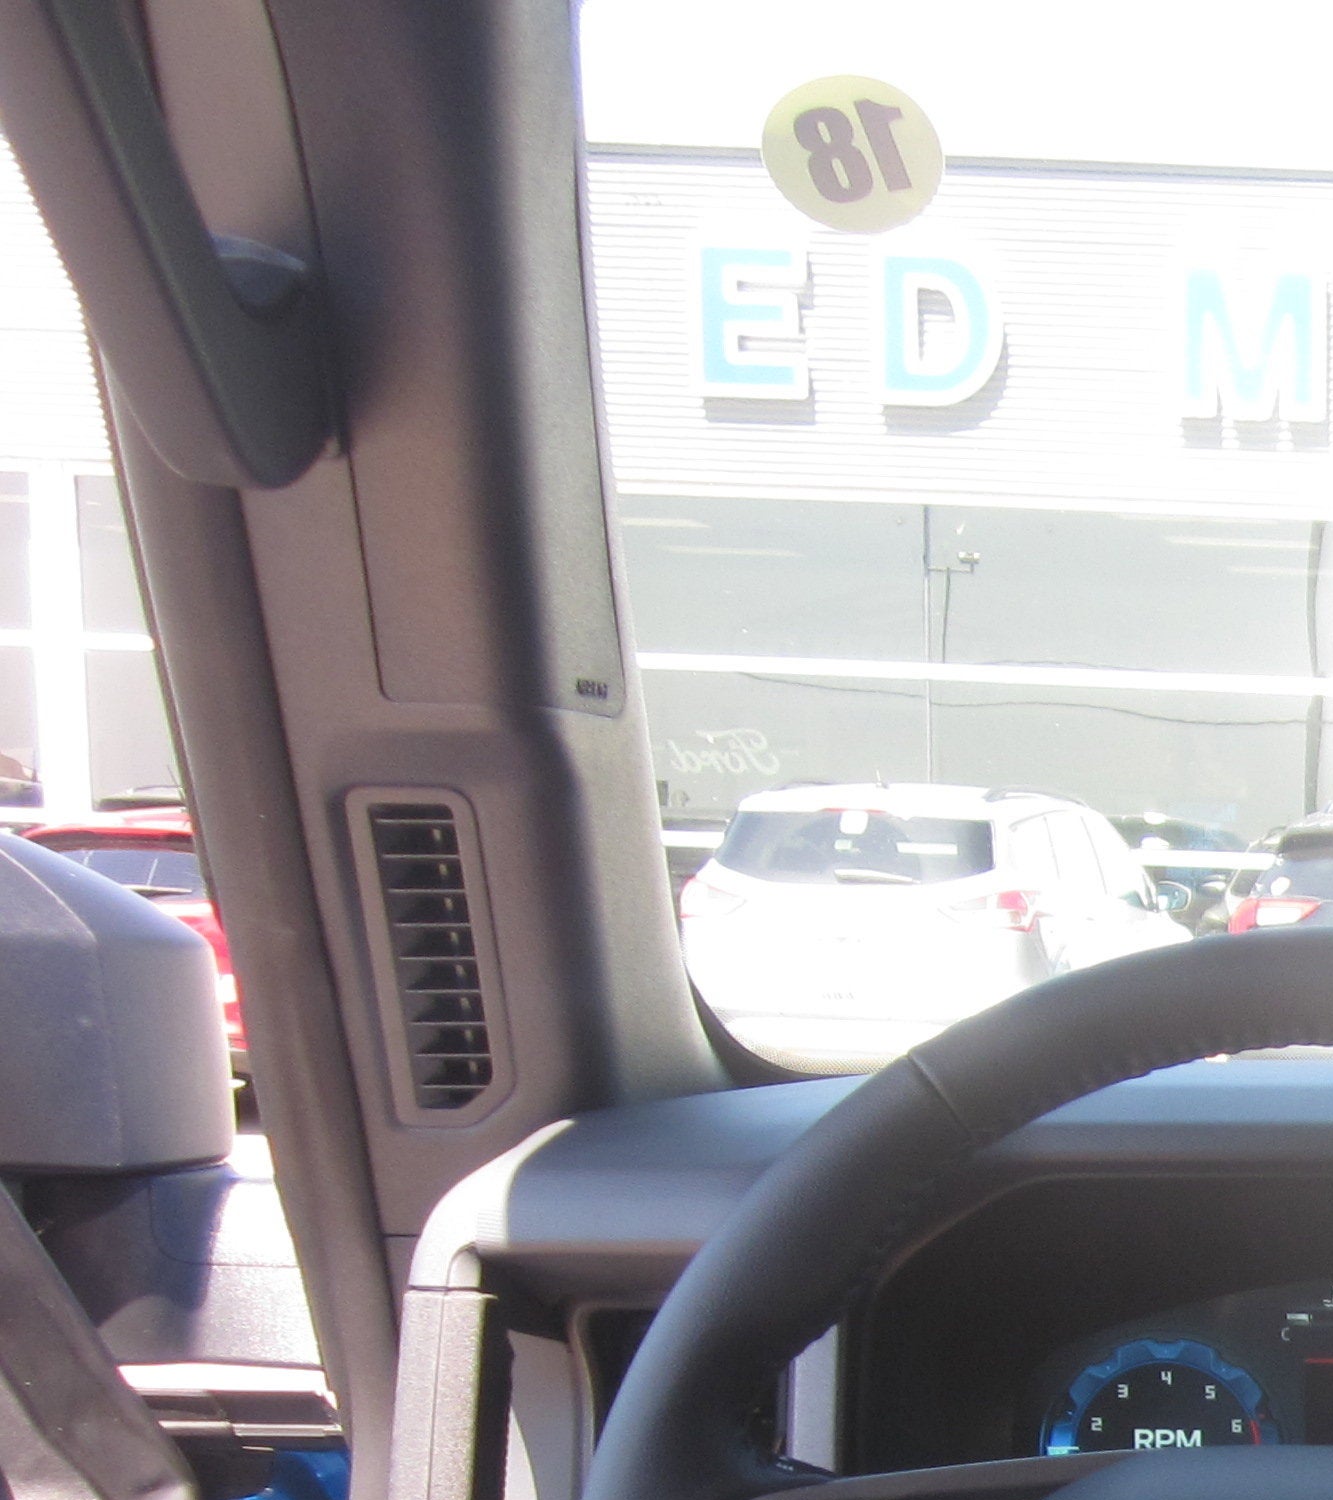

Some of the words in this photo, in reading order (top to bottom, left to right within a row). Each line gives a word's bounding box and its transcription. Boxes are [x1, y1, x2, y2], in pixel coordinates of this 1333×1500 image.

[696, 241, 1003, 405] ED
[1280, 1326, 1291, 1341] C
[1160, 1370, 1173, 1386] 4
[1116, 1383, 1129, 1399] 3
[1204, 1384, 1217, 1400] 5
[1090, 1416, 1103, 1432] 2
[1230, 1418, 1243, 1434] 6
[1133, 1428, 1203, 1450] RPM
